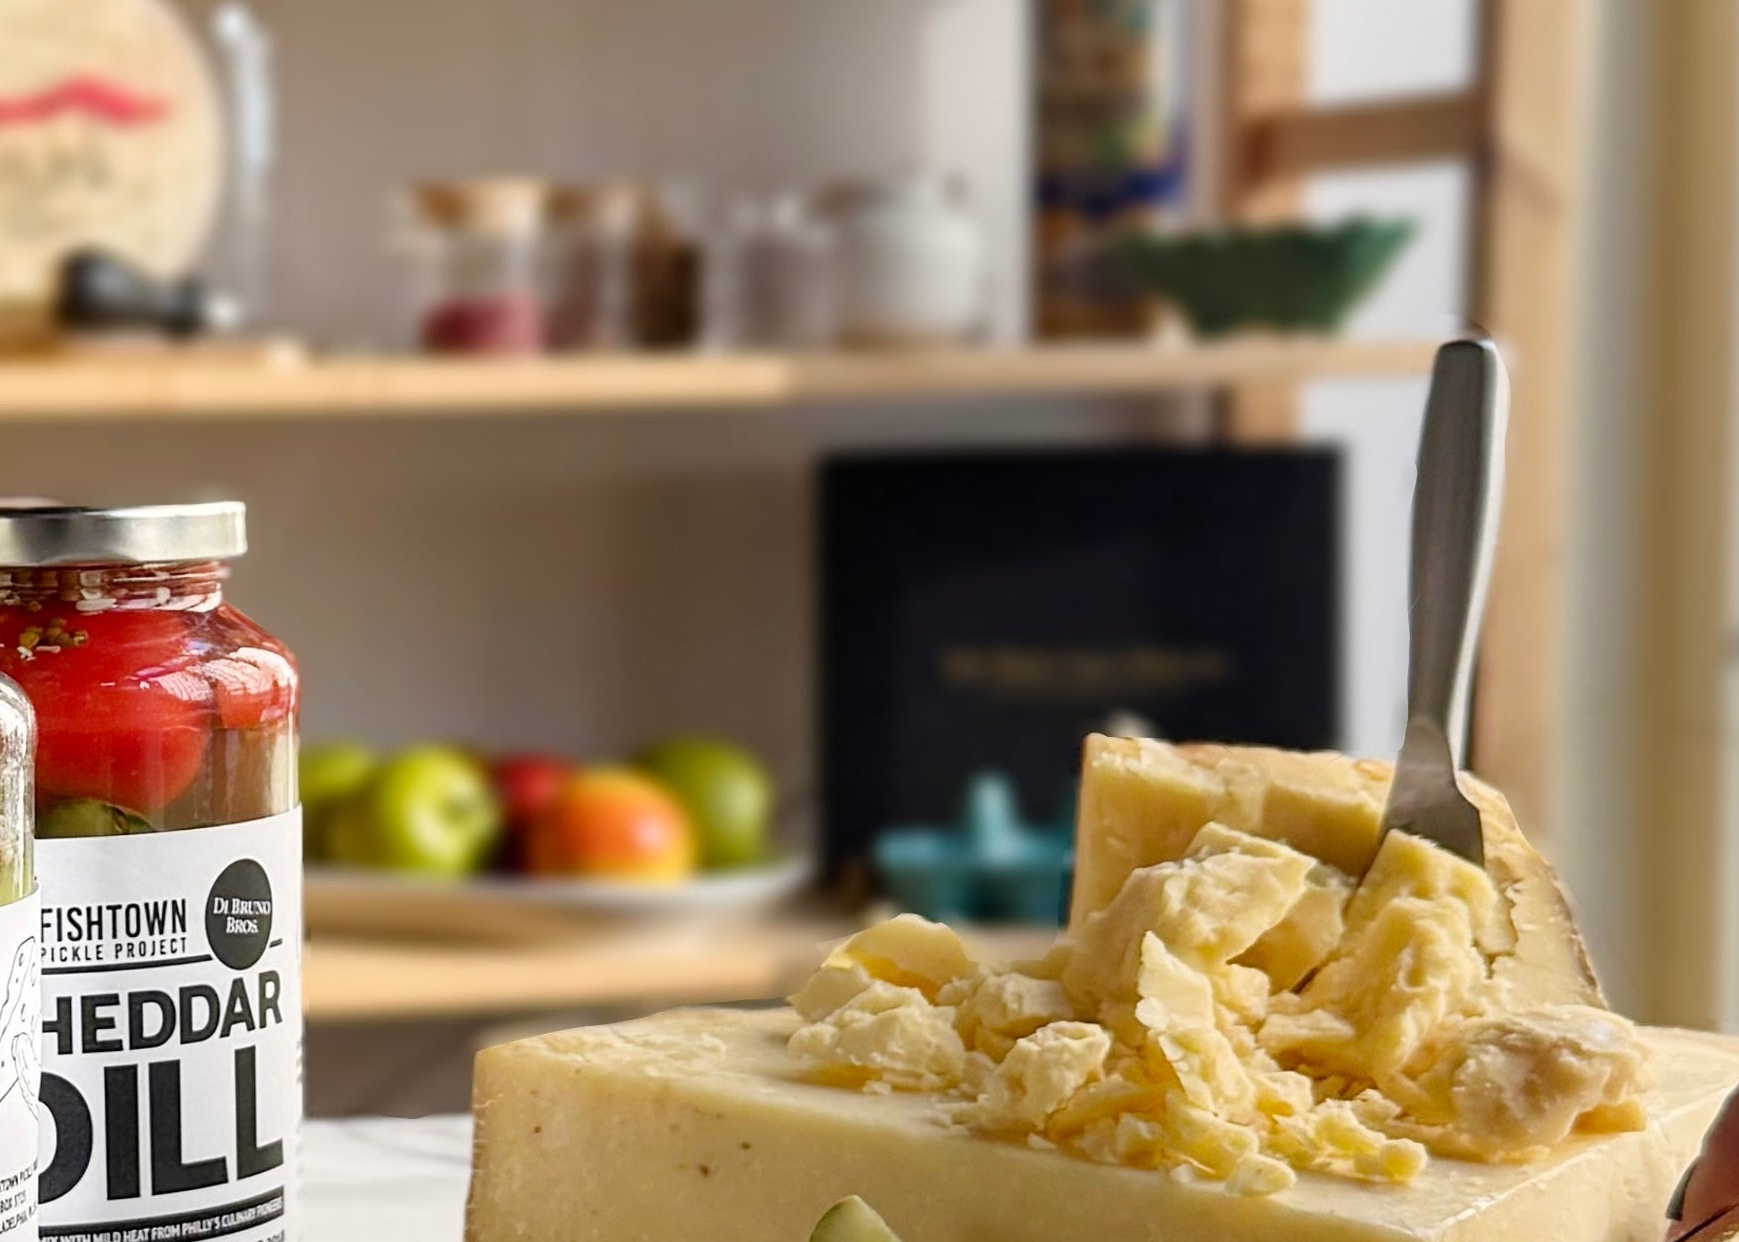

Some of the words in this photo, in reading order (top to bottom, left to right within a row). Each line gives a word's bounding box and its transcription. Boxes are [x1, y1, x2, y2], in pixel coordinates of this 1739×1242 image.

[41, 898, 187, 943] FISHTOWN
[115, 937, 187, 960] PROJECT
[42, 970, 283, 1055] HEDDAR
[151, 1222, 180, 1240] FROM
[182, 1215, 221, 1236] PHILLY'S
